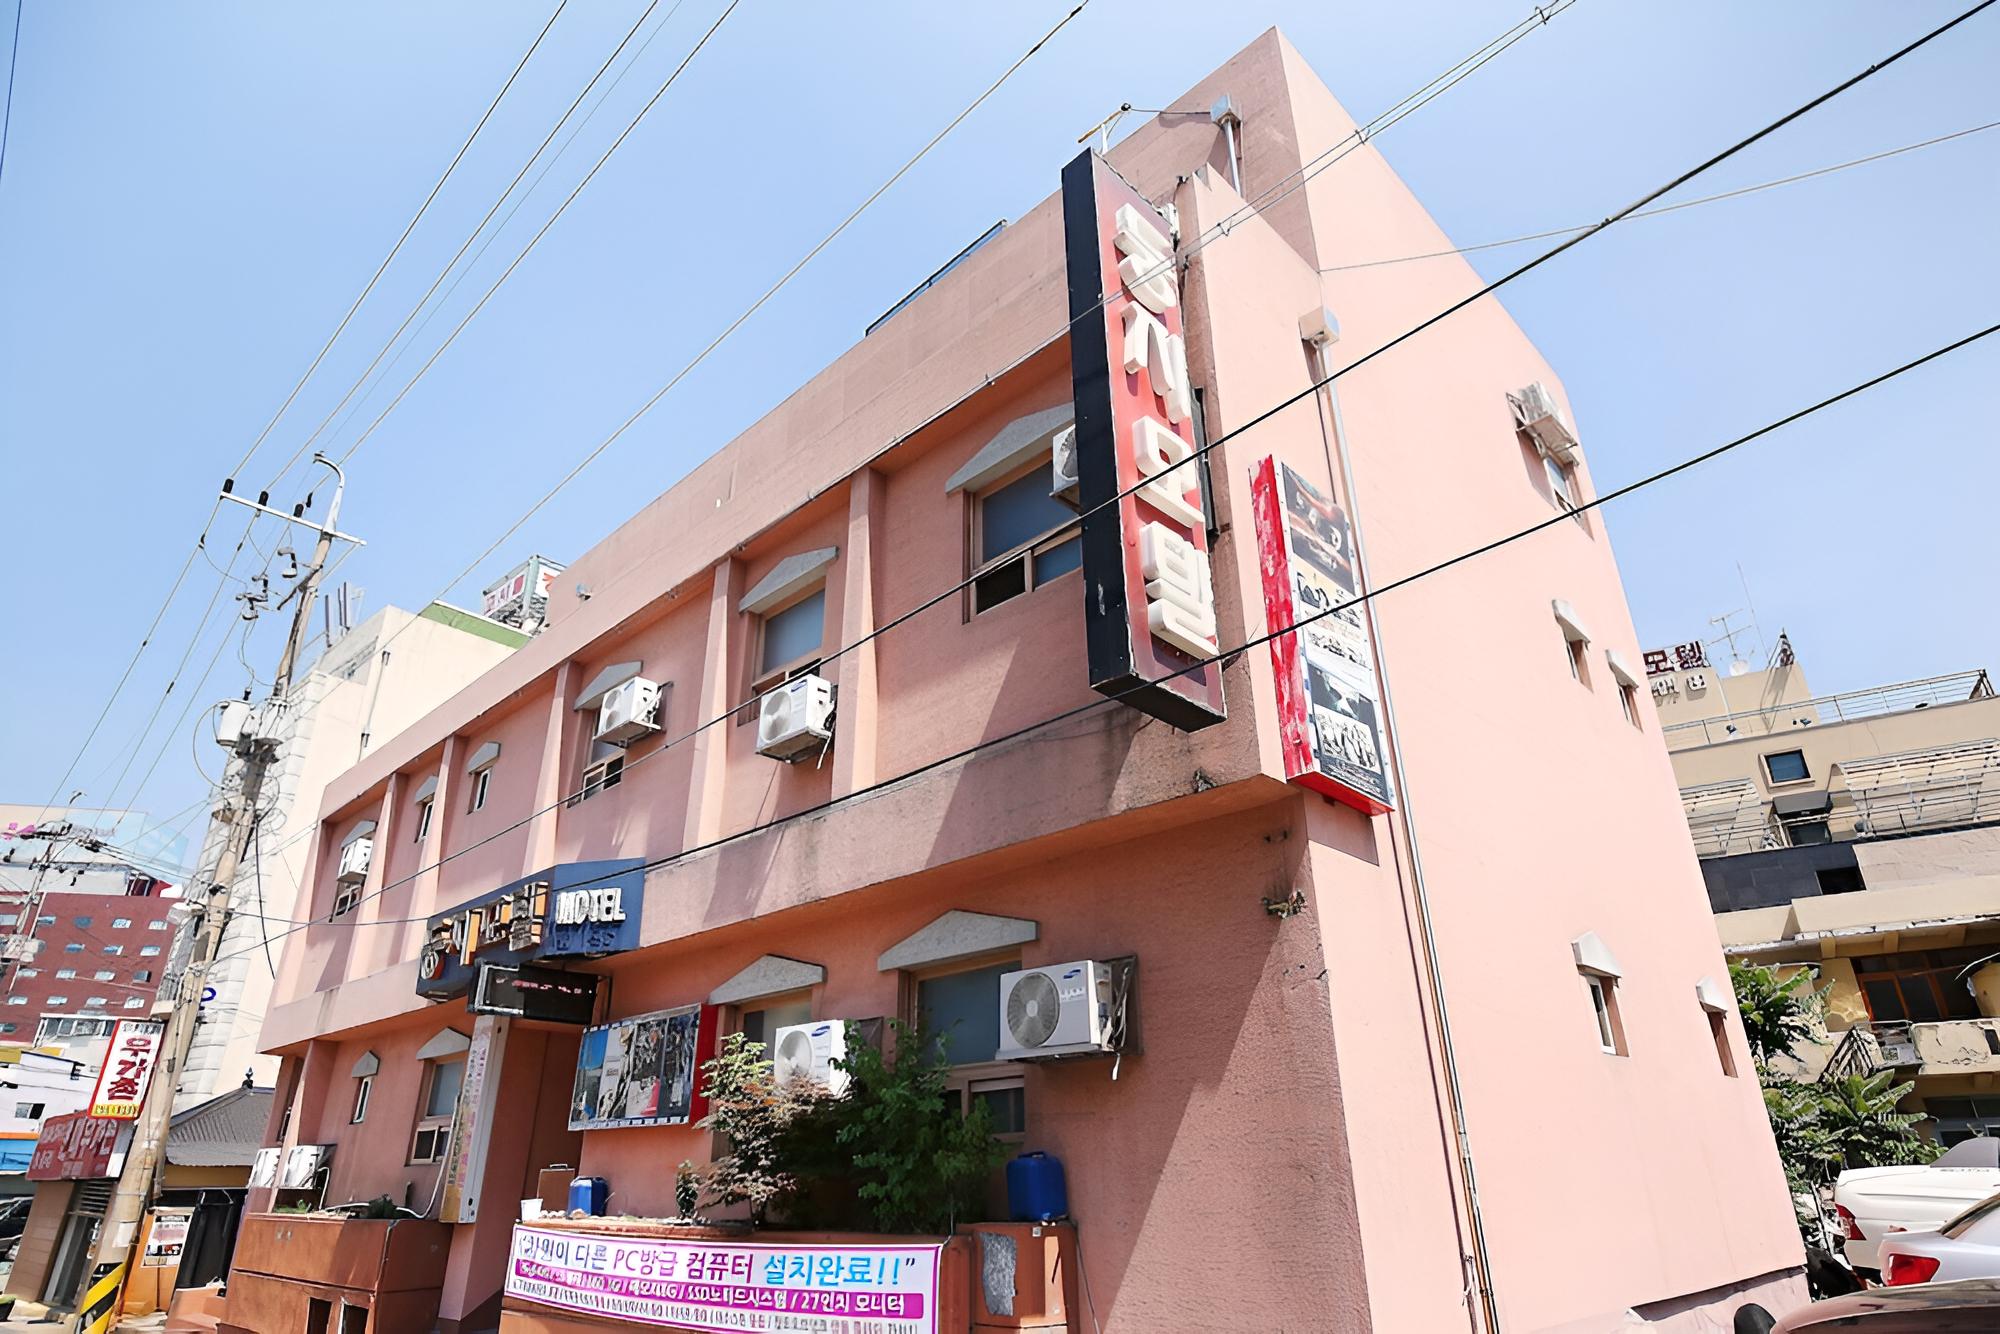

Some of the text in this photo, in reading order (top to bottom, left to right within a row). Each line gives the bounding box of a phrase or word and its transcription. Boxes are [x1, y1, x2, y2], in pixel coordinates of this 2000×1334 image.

[555, 887, 627, 925] MOTEL
[575, 1243, 608, 1271] 다른
[613, 1248, 679, 1277] PC방급
[686, 1251, 754, 1284] 컴퓨터
[853, 1294, 906, 1317] 모니터
